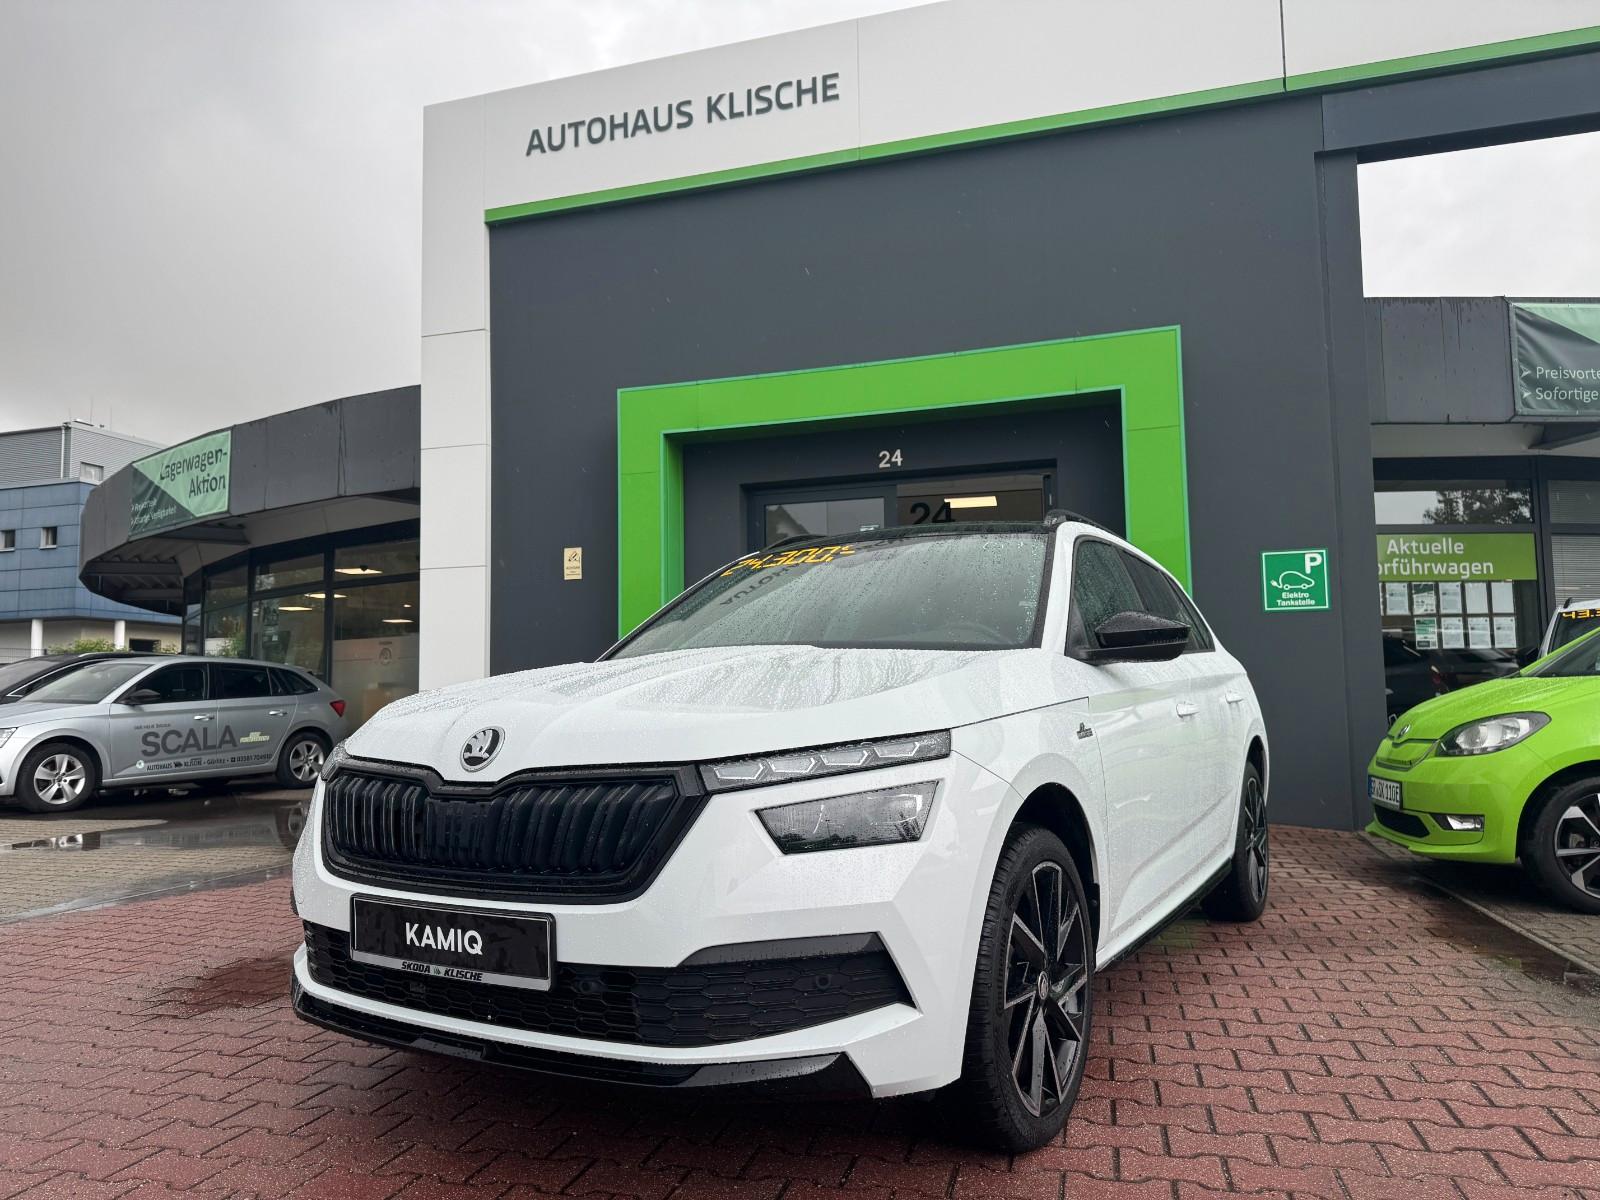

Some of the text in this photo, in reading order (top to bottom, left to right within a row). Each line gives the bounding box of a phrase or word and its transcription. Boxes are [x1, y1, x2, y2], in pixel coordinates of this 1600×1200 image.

[526, 72, 840, 157] AUTOHAUS KLISCHE
[1536, 386, 1599, 403] Sofortige
[160, 448, 228, 482] Lagerwagen-
[878, 449, 903, 469] 24
[188, 473, 226, 499] Aktion
[910, 502, 956, 525] 24
[1386, 537, 1465, 555] Aktuelle
[1305, 553, 1322, 575] P
[1281, 591, 1309, 599] Elektro
[141, 725, 238, 757] SCALA
[405, 922, 483, 955] KAMIQ
[401, 961, 483, 982] SKODA KLISCHE
